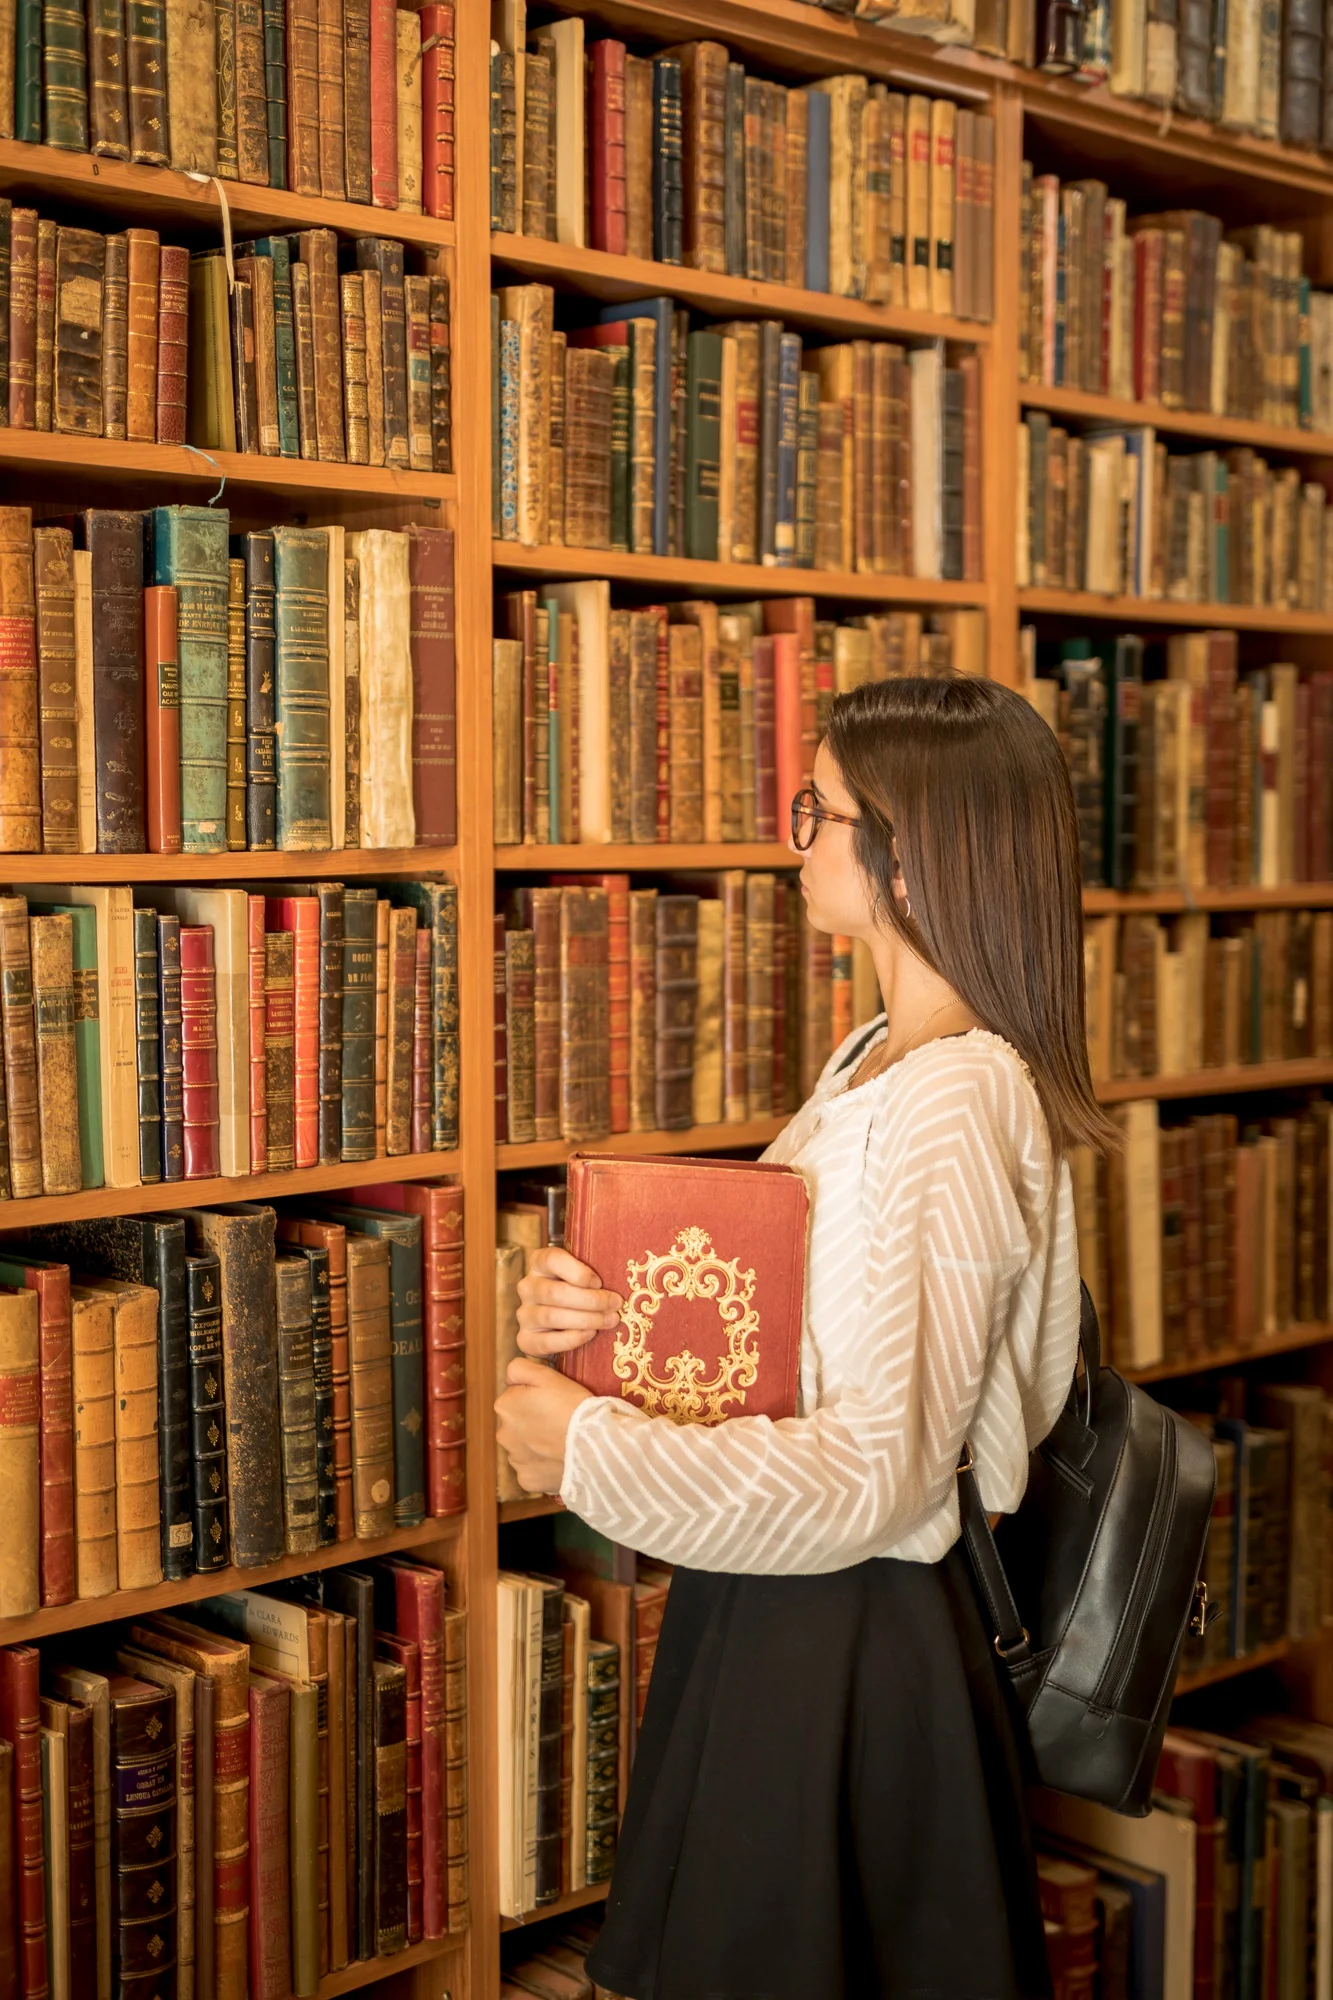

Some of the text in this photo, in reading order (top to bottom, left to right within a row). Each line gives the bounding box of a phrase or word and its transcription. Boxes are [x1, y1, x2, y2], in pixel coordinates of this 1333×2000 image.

[256, 1609, 282, 1626] CLARA
[262, 1623, 300, 1645] EDWARDS
[125, 1790, 151, 1803] LENGUA
